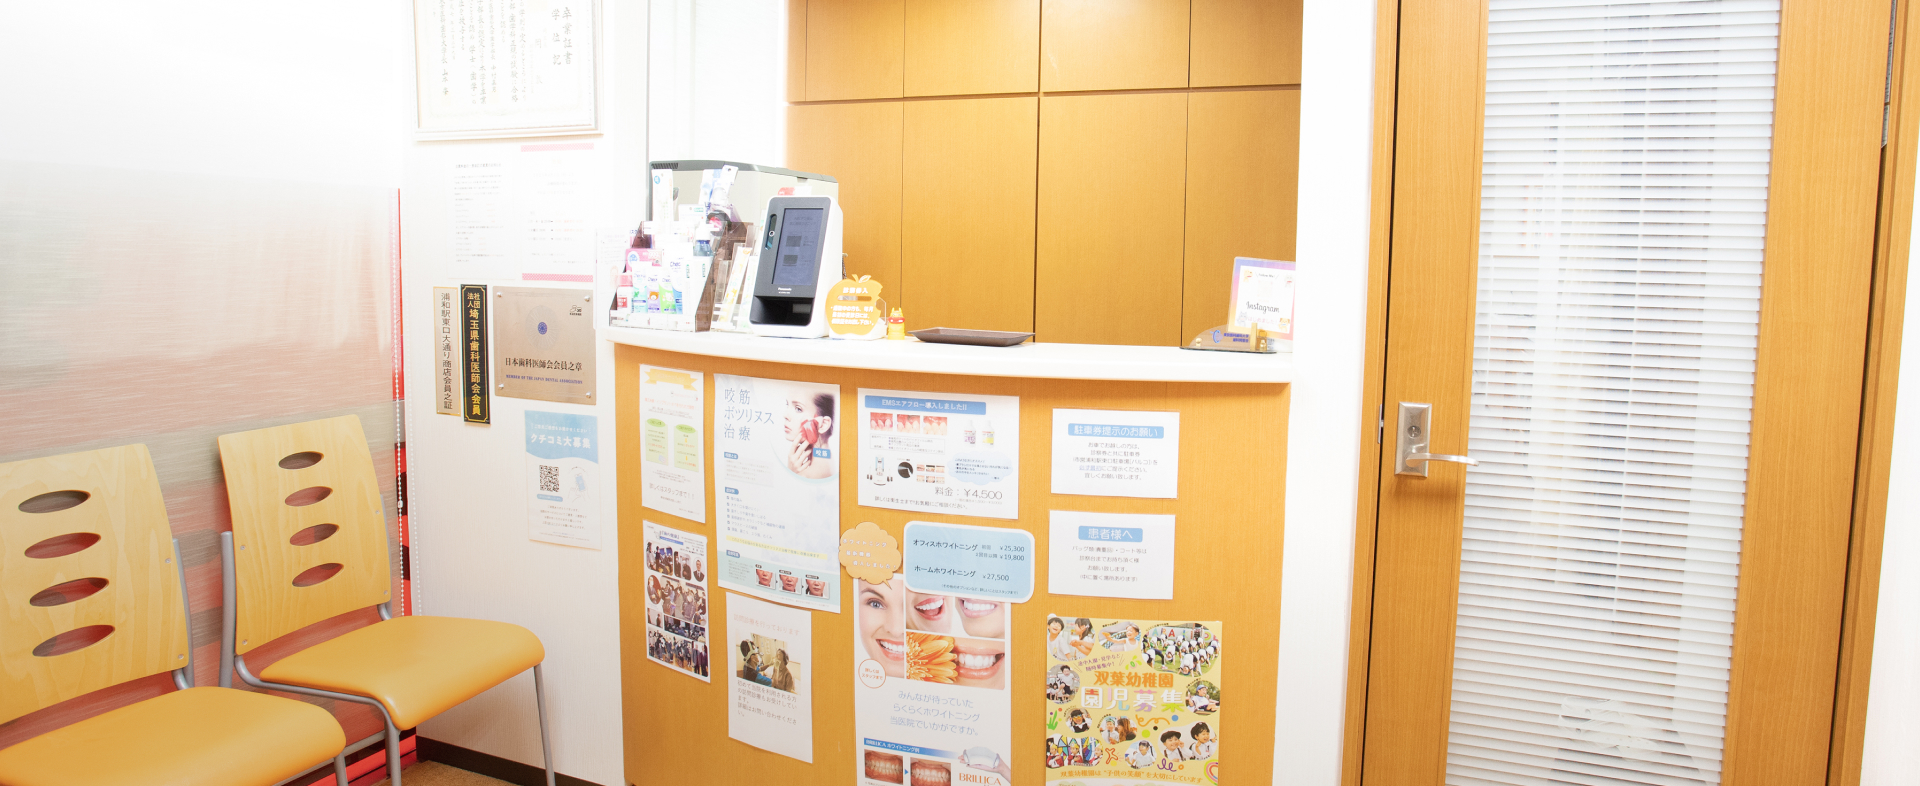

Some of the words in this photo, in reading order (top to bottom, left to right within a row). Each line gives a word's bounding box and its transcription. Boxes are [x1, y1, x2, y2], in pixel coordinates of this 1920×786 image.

[551, 8, 562, 66] 学位記
[562, 6, 573, 65] 卒業証書
[1246, 301, 1280, 314] Instagram
[469, 309, 482, 416] 埼玉県歯科医師会会員
[505, 357, 582, 372] 日本歯科医師会会員之章
[724, 387, 751, 406] 咬筋
[882, 399, 968, 411] EMSエアフロー導入しました!!
[724, 405, 775, 425] ボツリヌス
[724, 423, 751, 441] 治療
[1073, 425, 1158, 438] 駐車券提示のお願い
[530, 433, 591, 449] クチコミ大募集
[815, 449, 828, 457] 咬筋
[1088, 527, 1133, 540] 患者様へ
[842, 538, 887, 548] ホワイトニング
[913, 538, 978, 552] オフィスホワイトニング
[999, 545, 1025, 553] ¥25,300
[853, 560, 897, 570] 導入しました!
[999, 553, 1025, 562] ¥19,800
[914, 565, 976, 578] ホームホワイトニング
[982, 573, 1010, 582] ¥27,500
[861, 673, 883, 681] スタッフまで
[1093, 670, 1174, 688] 双葉幼稚園
[898, 690, 974, 709] みんなが待っていた
[1081, 686, 1185, 713] 園児募集
[737, 702, 797, 725] 詳細はお問い合わせくださ
[893, 703, 980, 723] らくらくホワイトニング
[890, 716, 979, 736] 当医院でいかがですか。
[958, 772, 1002, 786] BRILLICA
